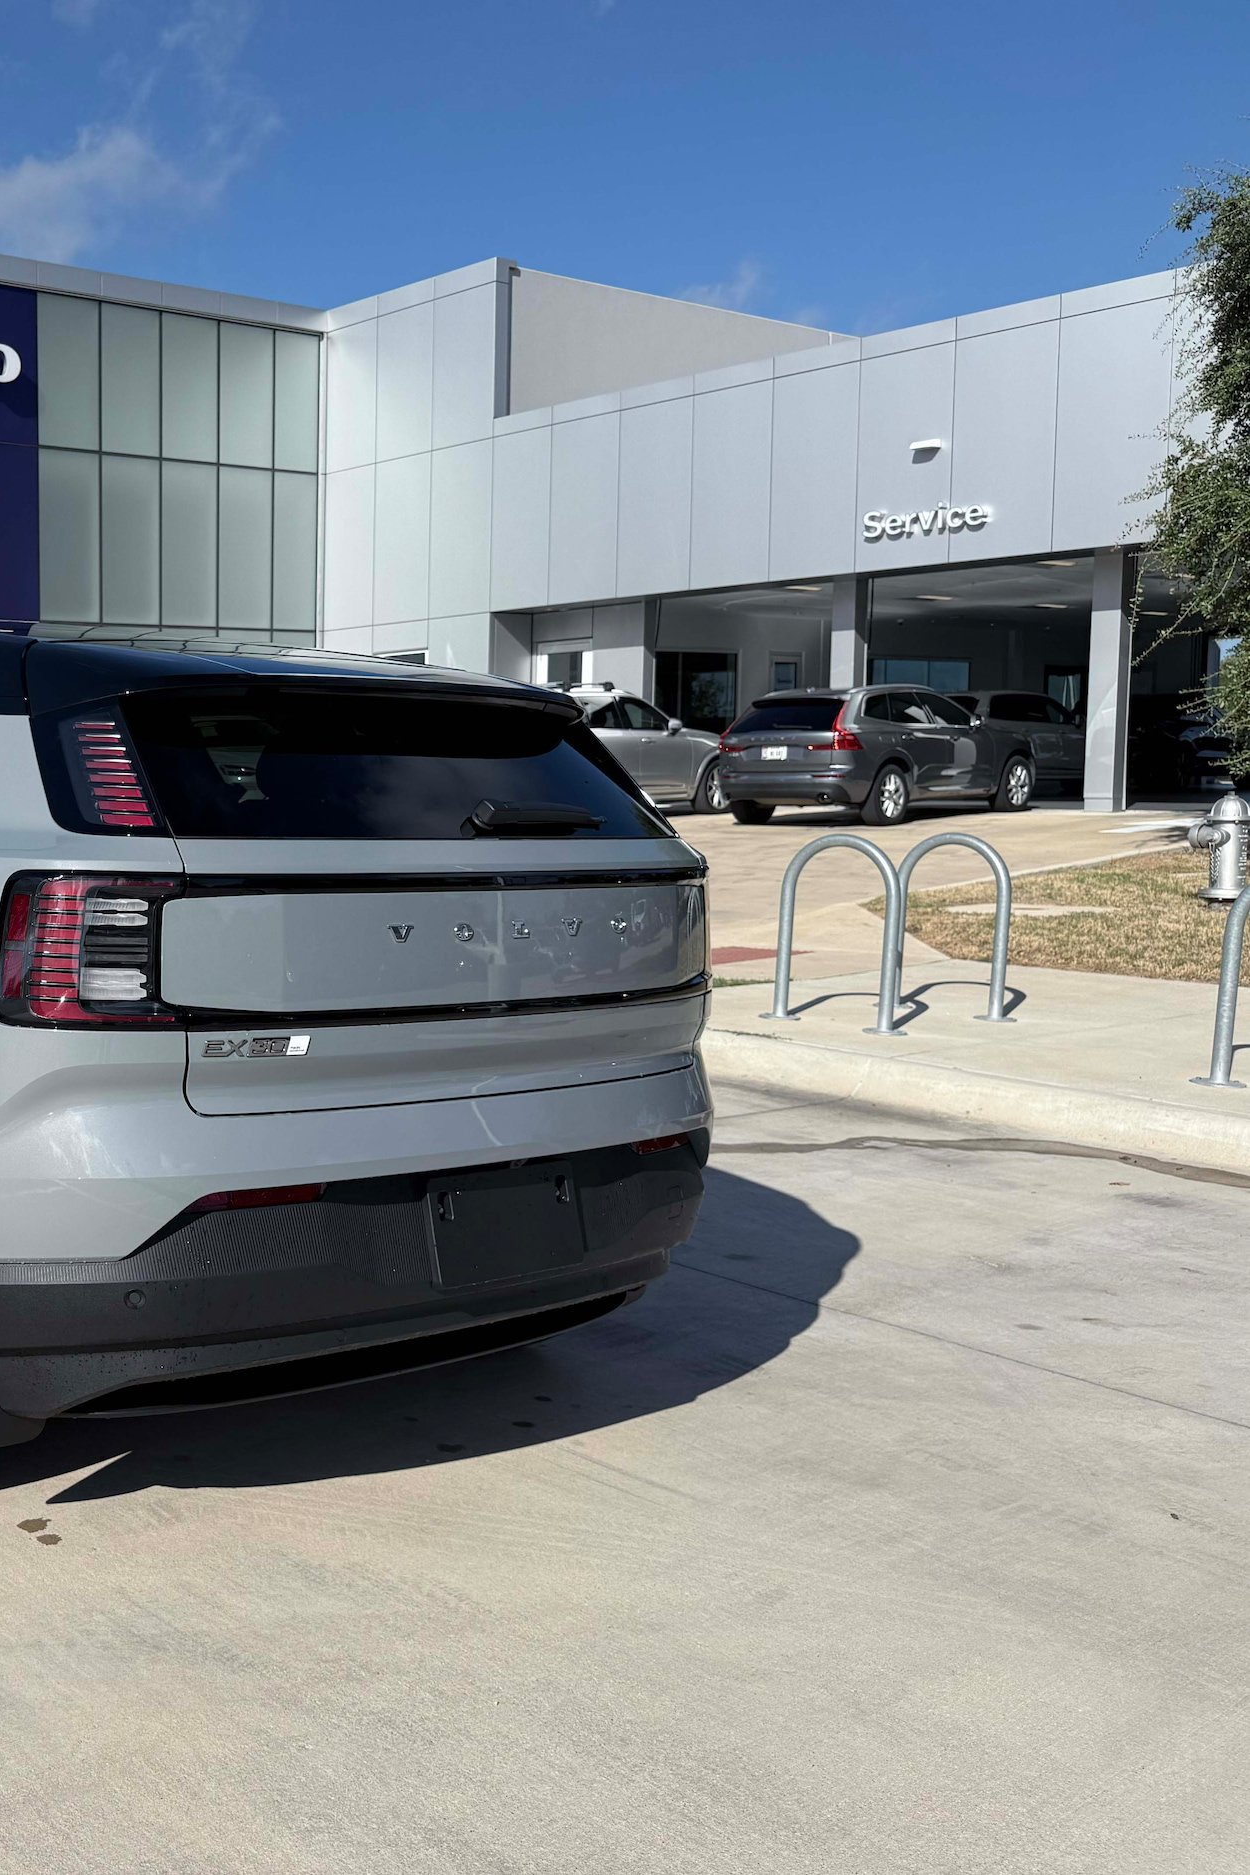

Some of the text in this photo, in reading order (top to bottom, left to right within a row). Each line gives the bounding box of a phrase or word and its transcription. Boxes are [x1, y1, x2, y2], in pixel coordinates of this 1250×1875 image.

[862, 501, 985, 538] Service
[386, 916, 627, 943] VOLVO
[201, 1038, 289, 1058] EX30
